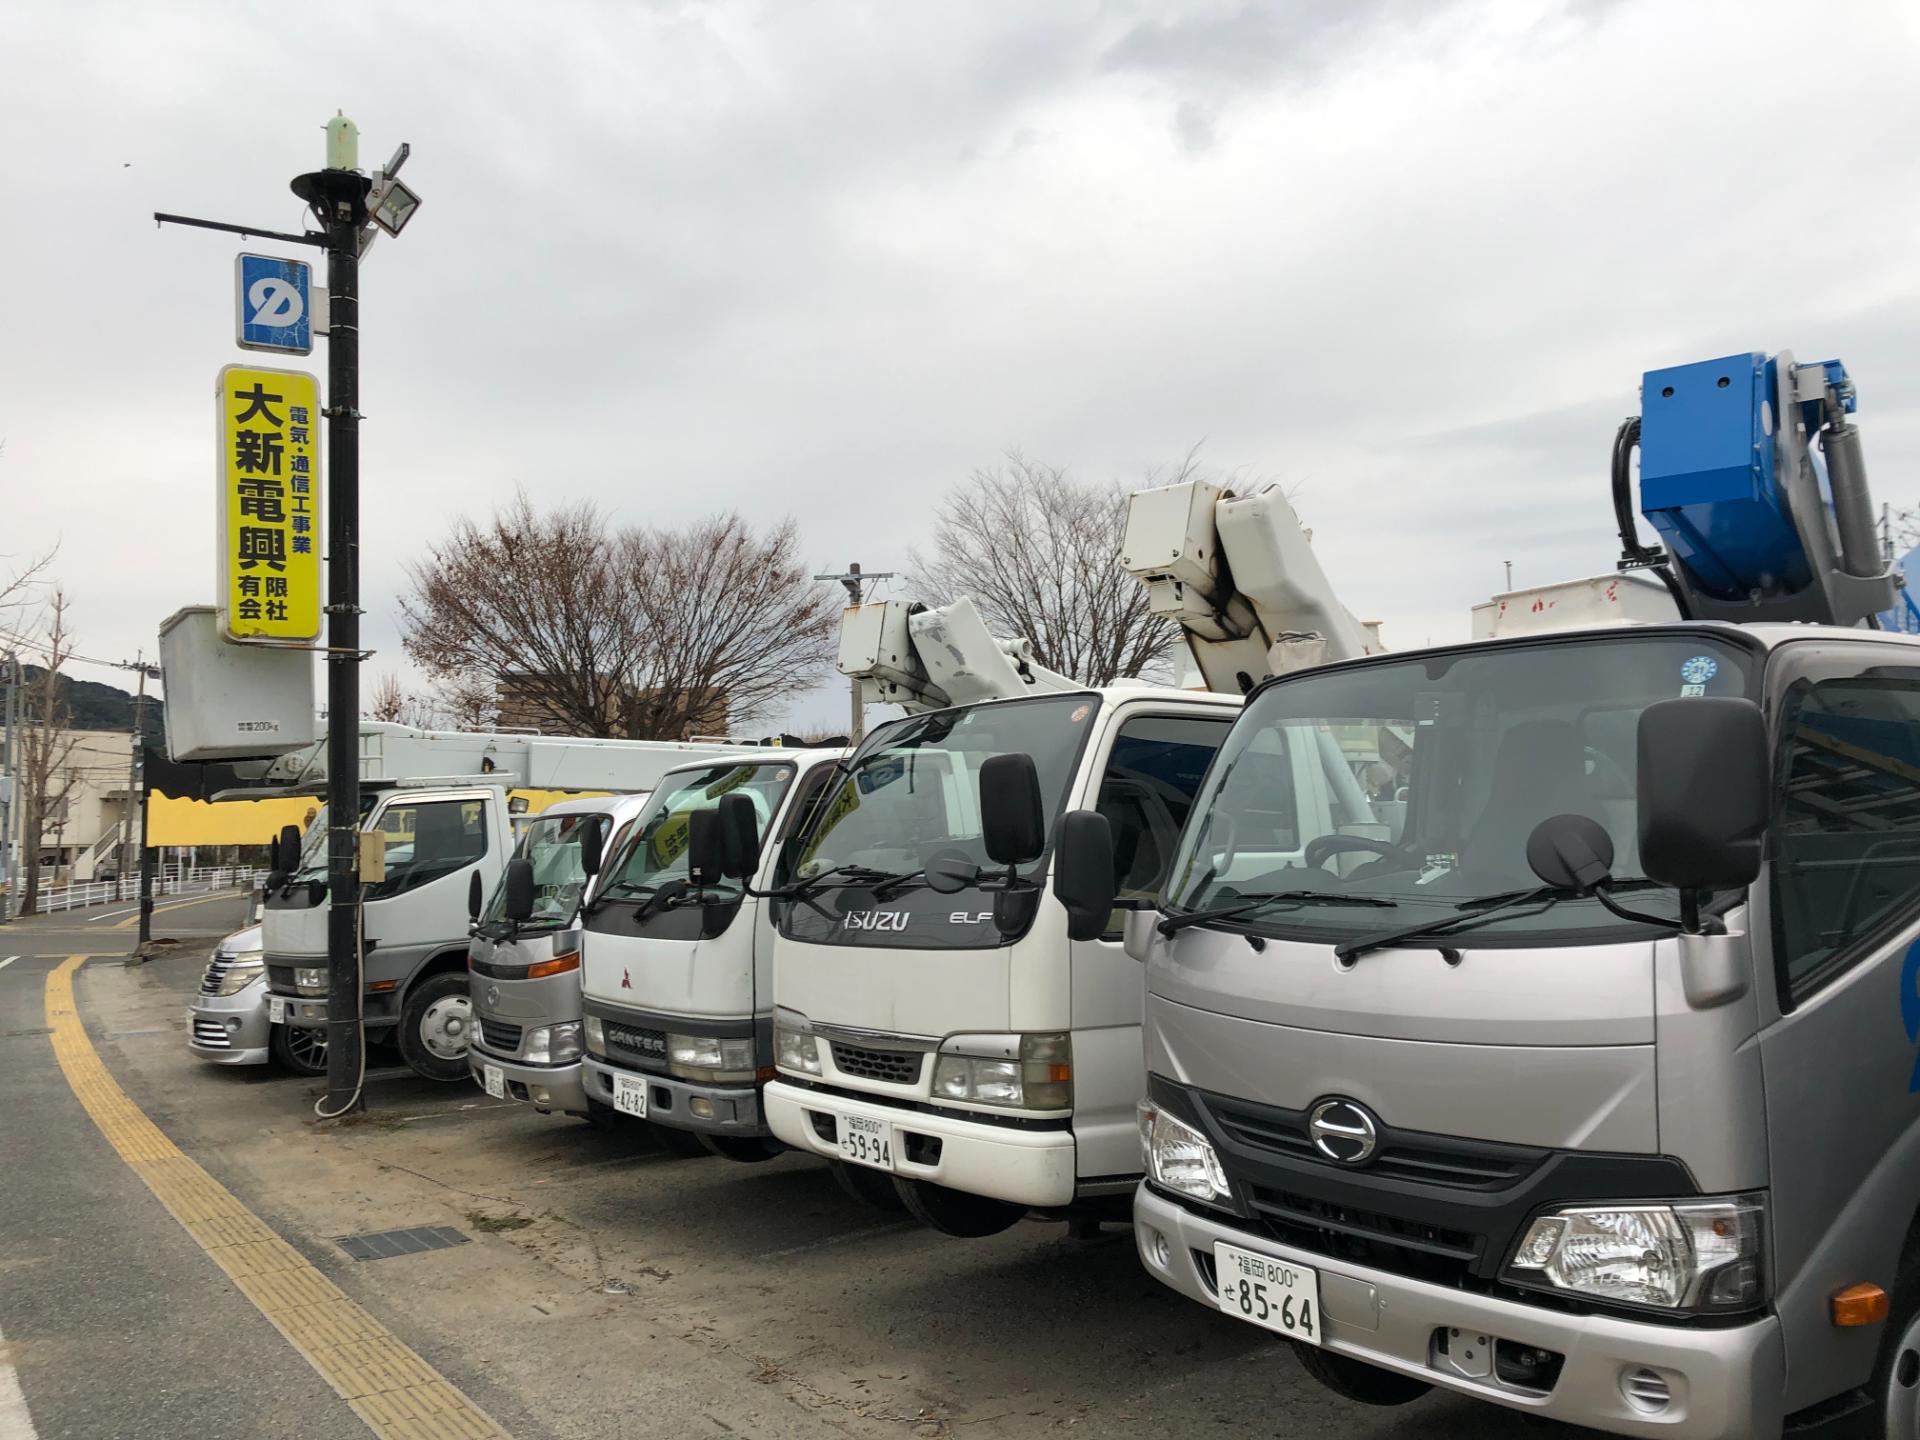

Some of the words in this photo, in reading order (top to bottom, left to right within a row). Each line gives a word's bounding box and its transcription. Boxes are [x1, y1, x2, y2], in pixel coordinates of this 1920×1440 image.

[234, 383, 287, 573] 大新電興
[289, 406, 311, 554] 電気・通信工事業
[844, 911, 911, 931] ISUZU
[950, 911, 994, 924] ELF
[608, 1029, 667, 1053] CANTER
[849, 1131, 891, 1167] 59-94
[1238, 1255, 1265, 1280] 福岡
[1267, 1264, 1293, 1288] 800
[1239, 1279, 1313, 1337] 85-64
